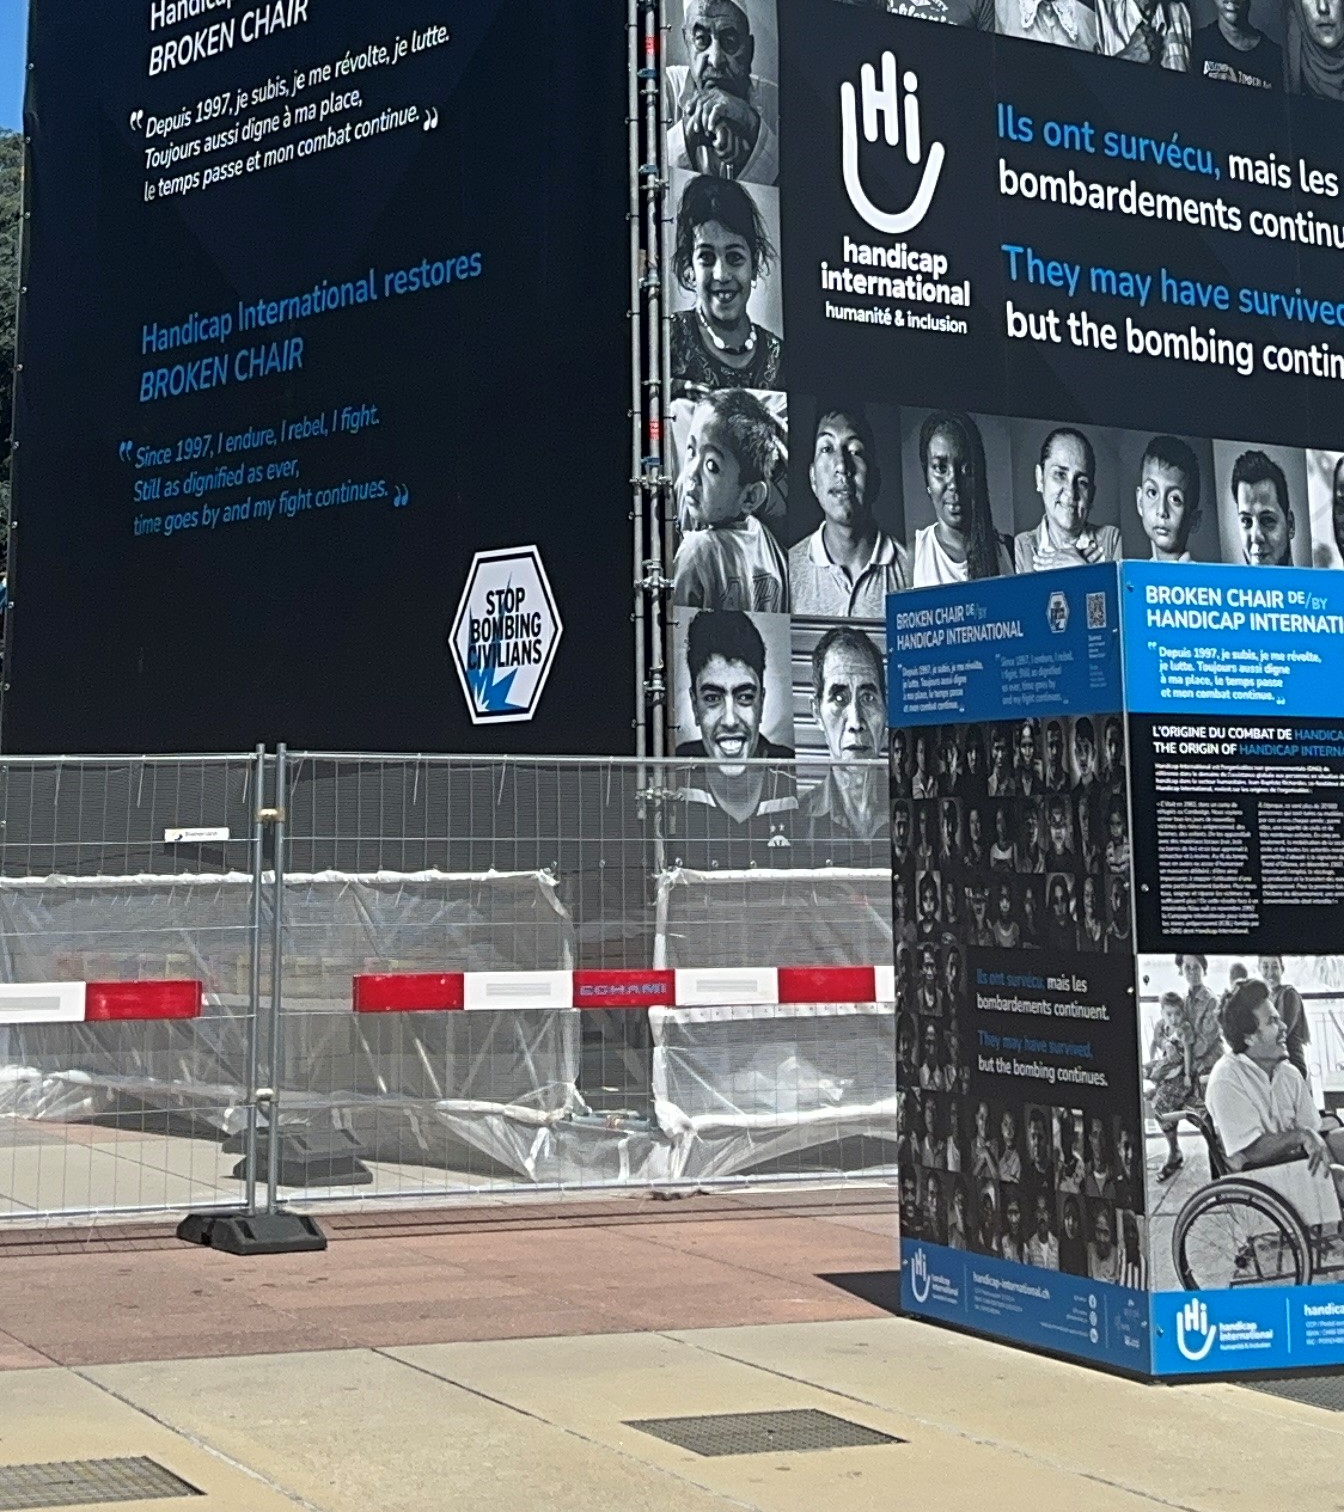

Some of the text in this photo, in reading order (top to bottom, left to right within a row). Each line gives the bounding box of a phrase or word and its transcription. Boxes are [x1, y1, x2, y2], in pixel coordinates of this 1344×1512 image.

[148, 17, 235, 76] BROKEN
[194, 91, 233, 123] 1997,
[233, 87, 248, 115] je
[250, 74, 289, 105] subis,
[290, 69, 305, 97] je
[307, 64, 331, 86] me
[334, 44, 390, 78] révolte,
[390, 37, 408, 65] je
[410, 25, 449, 53] lutte.
[144, 89, 362, 169] Toujours aussi digne à ma place,
[997, 102, 1339, 197] Ils ont survécu, mais les
[143, 180, 156, 201] le
[157, 171, 200, 197] temps
[201, 159, 243, 189] passe
[245, 149, 261, 172] et
[262, 143, 294, 168] mon
[296, 122, 352, 157] combat
[998, 157, 1242, 231] bombardements
[843, 236, 948, 277] handicap
[1000, 243, 1080, 297] They
[1089, 266, 1151, 307] may
[1160, 267, 1229, 310] have
[141, 251, 482, 354] Handicap International restores
[821, 262, 970, 307] international
[825, 302, 968, 334] humanité & inclusion
[1005, 299, 1061, 343] but
[1065, 310, 1117, 350] the
[1125, 316, 1253, 375] bombing
[139, 336, 303, 402] BROKEN CHAIR
[174, 433, 214, 462] 1997,
[216, 431, 223, 454] I
[224, 425, 277, 452] endure,
[280, 419, 286, 442] I
[287, 411, 328, 440] rebel,
[331, 409, 337, 431] I
[340, 403, 380, 434] fight.
[133, 458, 299, 502] Still as dignified as ever,
[133, 513, 162, 535] time
[163, 510, 199, 536] goes
[200, 502, 220, 529] by
[221, 495, 251, 522] and
[252, 498, 276, 521] my
[278, 487, 313, 517] fight
[486, 586, 525, 616] STOP
[897, 609, 933, 630] BROKEN
[935, 605, 964, 624] CHAIR
[1146, 585, 1222, 606] BROKEN
[1227, 588, 1284, 608] CHAIR
[470, 611, 542, 644] BOMBING
[897, 620, 1024, 650] HANDICAP INTERNATIONAL
[1147, 609, 1245, 630] HANDICAP
[467, 639, 542, 670] CIVILIANS
[1153, 726, 1207, 740] L'ORIGINE
[1209, 727, 1226, 740] DU
[1228, 728, 1275, 740] COMBAT
[1277, 728, 1292, 741] DE
[1154, 741, 1177, 754] THE
[1179, 742, 1219, 755] ORIGIN
[1221, 743, 1237, 755] OF
[1240, 743, 1299, 757] HANDICAP
[1047, 974, 1087, 992] mais les
[977, 992, 1110, 1020] bombardements continuent.
[978, 1054, 1108, 1086] but the bombing continues.
